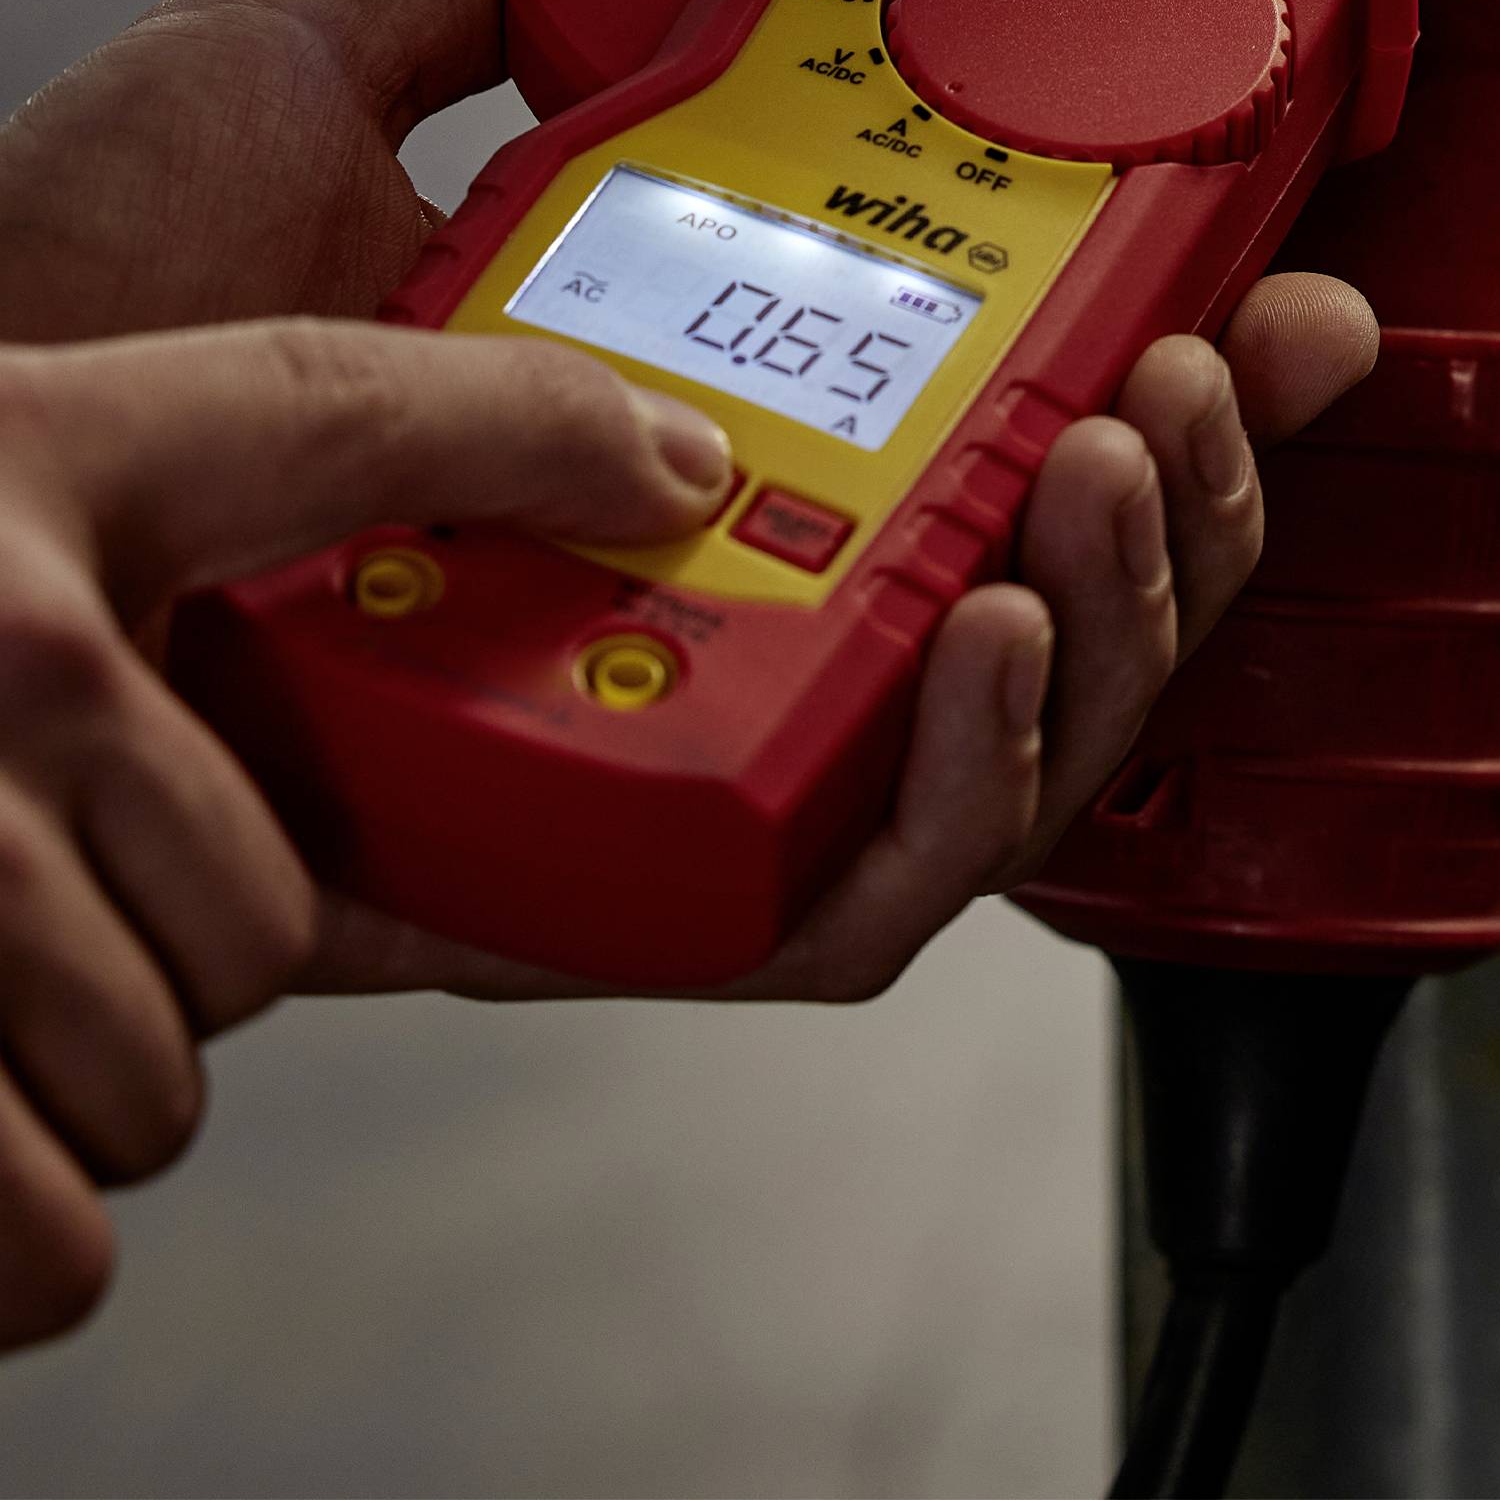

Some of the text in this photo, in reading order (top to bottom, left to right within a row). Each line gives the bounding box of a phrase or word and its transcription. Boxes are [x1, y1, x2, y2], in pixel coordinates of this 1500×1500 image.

[800, 57, 866, 86] AC/DC
[833, 48, 854, 66] V
[887, 119, 908, 137] A
[856, 127, 923, 159] AC/DC
[955, 160, 1013, 193] OFF
[677, 211, 738, 242] APO
[825, 185, 969, 254] wiha
[561, 276, 606, 304] AC
[833, 414, 857, 437] A
